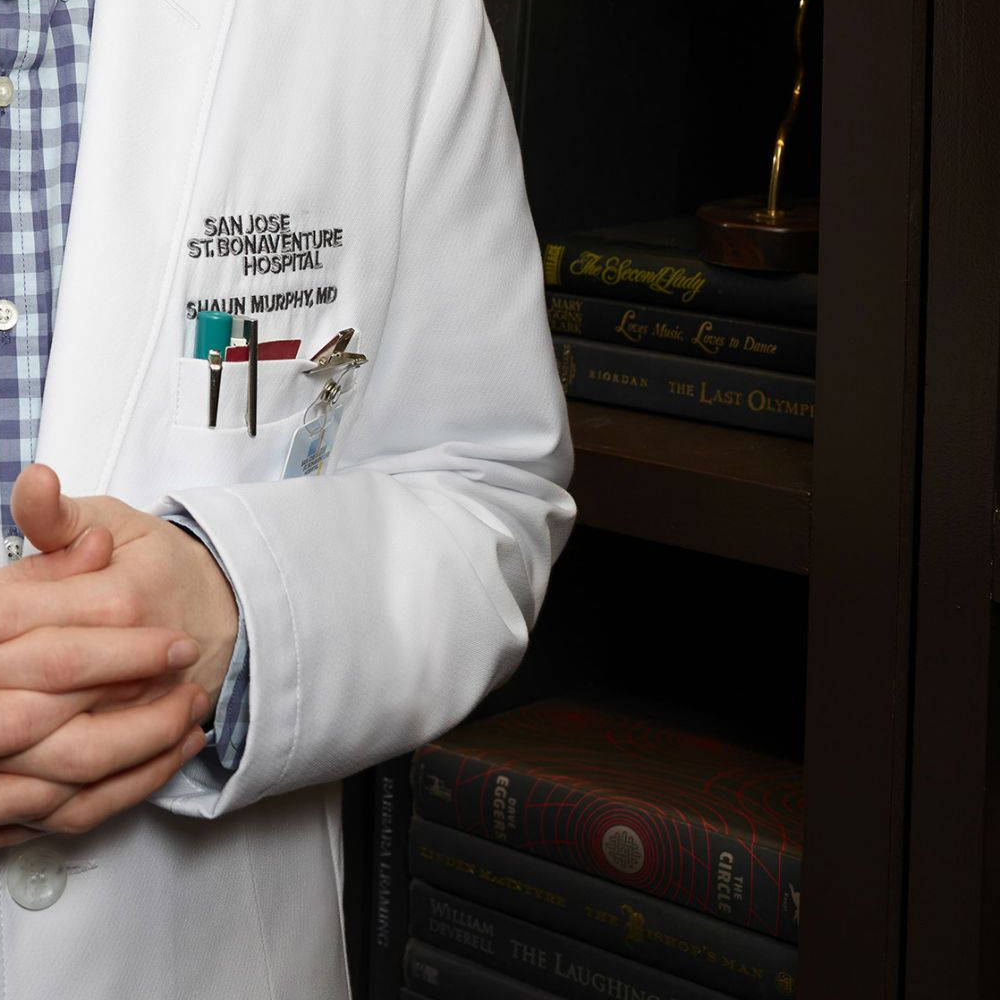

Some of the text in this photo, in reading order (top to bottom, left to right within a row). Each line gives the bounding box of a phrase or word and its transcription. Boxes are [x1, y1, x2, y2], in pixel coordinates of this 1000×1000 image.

[204, 213, 291, 237] SAN JOSE
[187, 228, 344, 258] ST. BONAVENTURE
[243, 250, 323, 276] HOSPITAL
[251, 289, 313, 314] MURPHY,
[316, 285, 338, 305] MD
[615, 309, 649, 343] Loves
[691, 320, 725, 355] Loves
[729, 336, 739, 349] to
[743, 335, 778, 355] Dance
[587, 368, 648, 388] RIORDAN
[667, 379, 695, 398] THE
[698, 380, 743, 407] LAST
[492, 775, 510, 841] EGGERS
[717, 850, 735, 915] CIRCLE
[733, 874, 744, 903] THE
[428, 898, 495, 937] WILLIAM
[510, 939, 548, 969] THE
